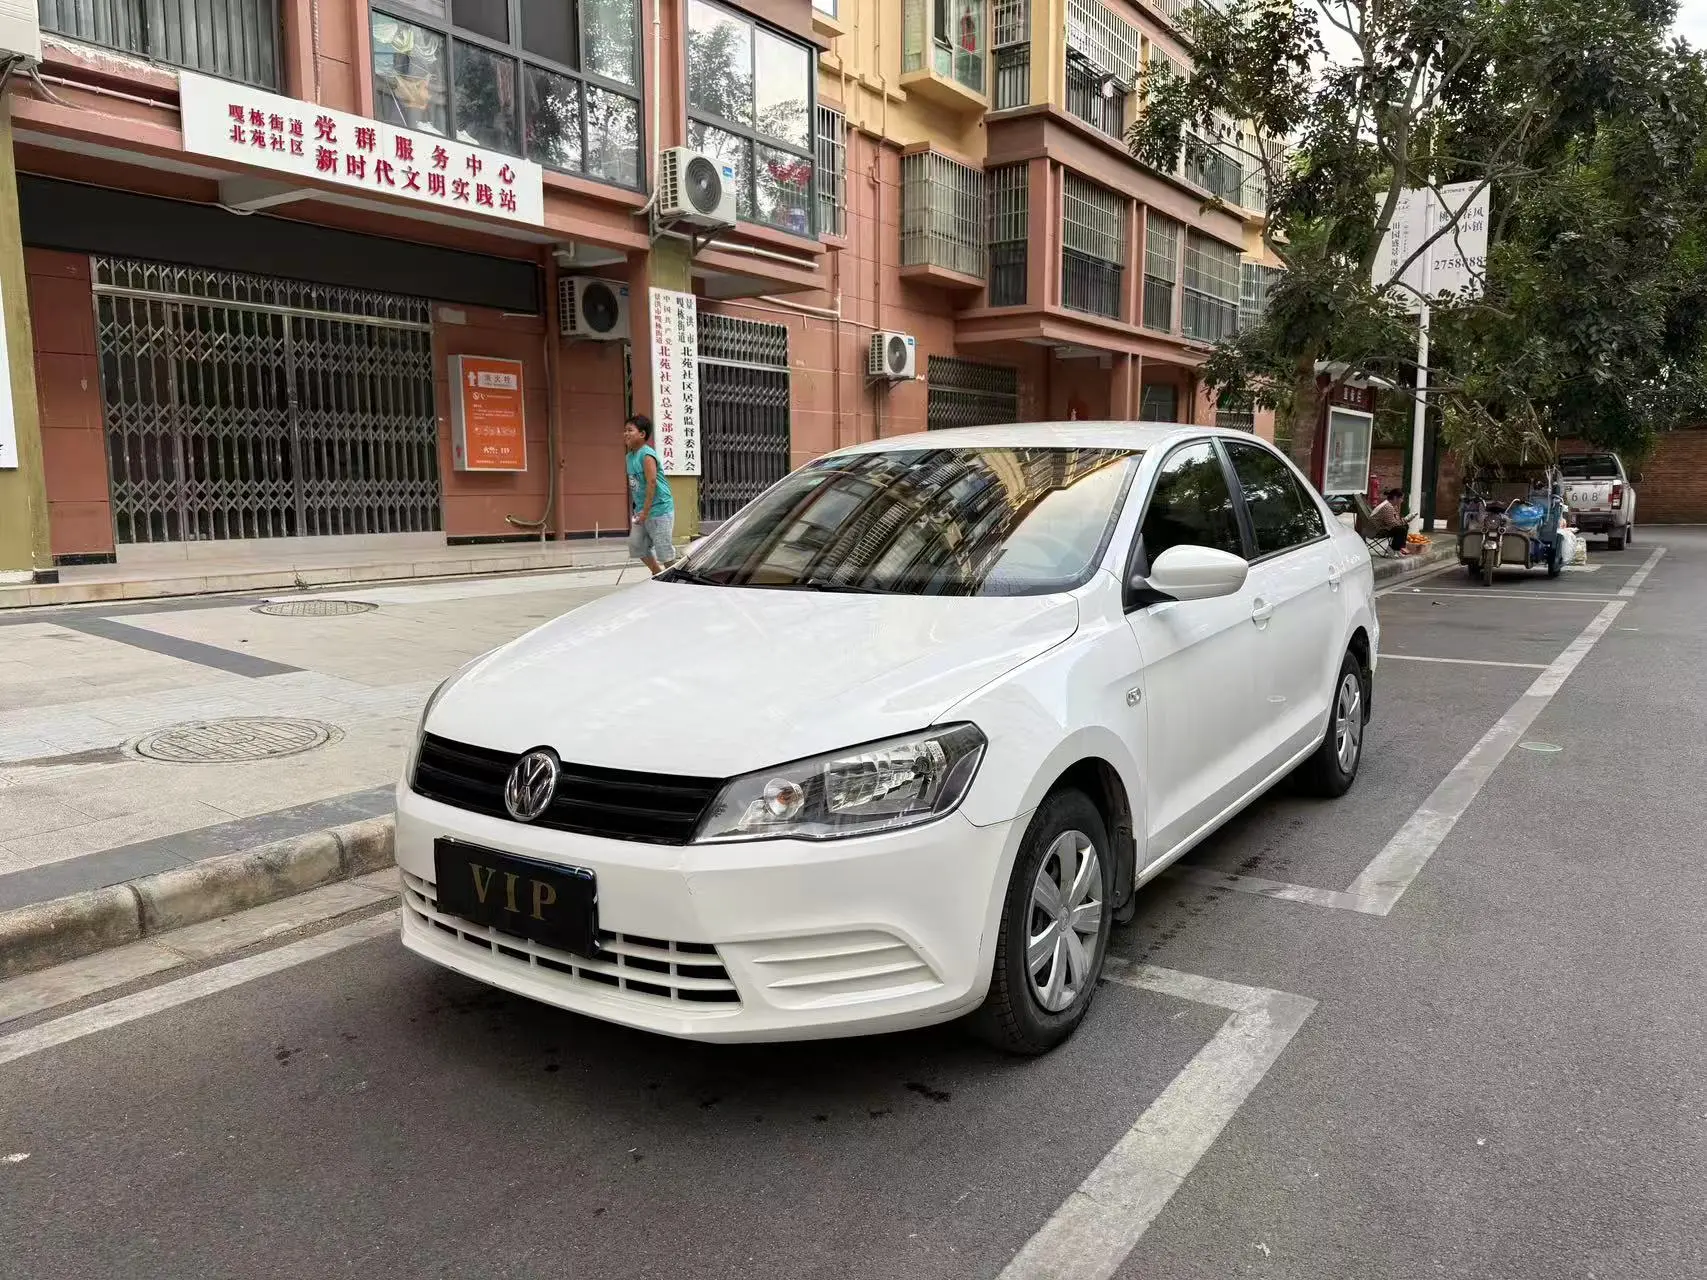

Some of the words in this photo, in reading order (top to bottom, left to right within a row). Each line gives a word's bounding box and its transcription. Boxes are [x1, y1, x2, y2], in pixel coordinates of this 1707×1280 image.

[229, 104, 304, 137] 嘎栋街道
[229, 124, 304, 156] 北苑社区
[314, 114, 517, 185] 党群服务中心
[315, 145, 518, 213] 新时代文明实践站
[659, 345, 675, 471] 北苑社区总支部委员会
[1571, 492, 1599, 502] 608
[468, 862, 558, 922] VIP
